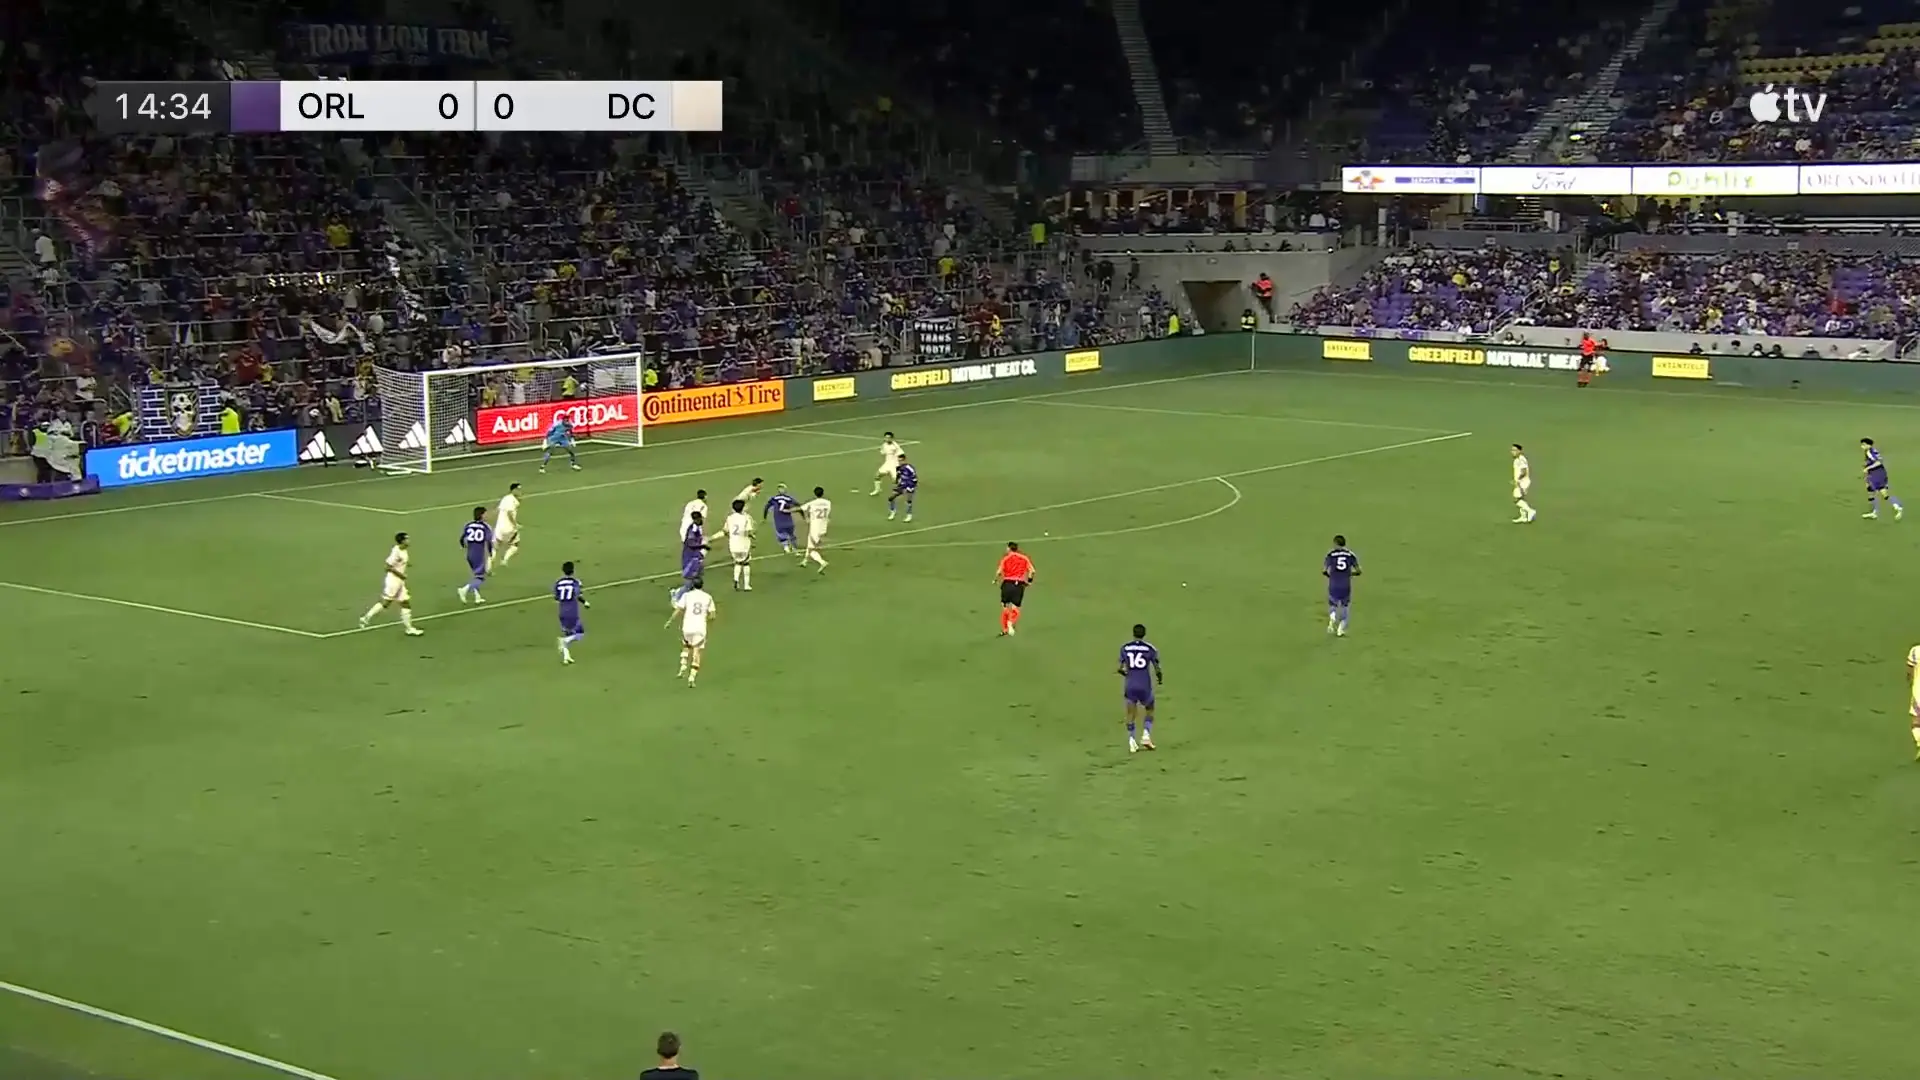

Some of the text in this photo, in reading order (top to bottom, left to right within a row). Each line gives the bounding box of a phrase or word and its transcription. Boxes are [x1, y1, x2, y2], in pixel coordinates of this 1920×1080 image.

[1408, 346, 1485, 365] GREENFIELD
[1486, 350, 1548, 368] NATURAL
[891, 368, 950, 390] GREENFIELD
[951, 363, 995, 383] NATURAL
[643, 384, 781, 422] Continental Tire
[492, 411, 540, 434] Audi
[118, 441, 271, 479] ticketmaster
[778, 499, 787, 511] 7
[467, 528, 484, 542] 20
[1336, 556, 1347, 570] 5
[557, 585, 573, 600] 77
[692, 601, 703, 616] 8
[1126, 652, 1147, 669] 16
